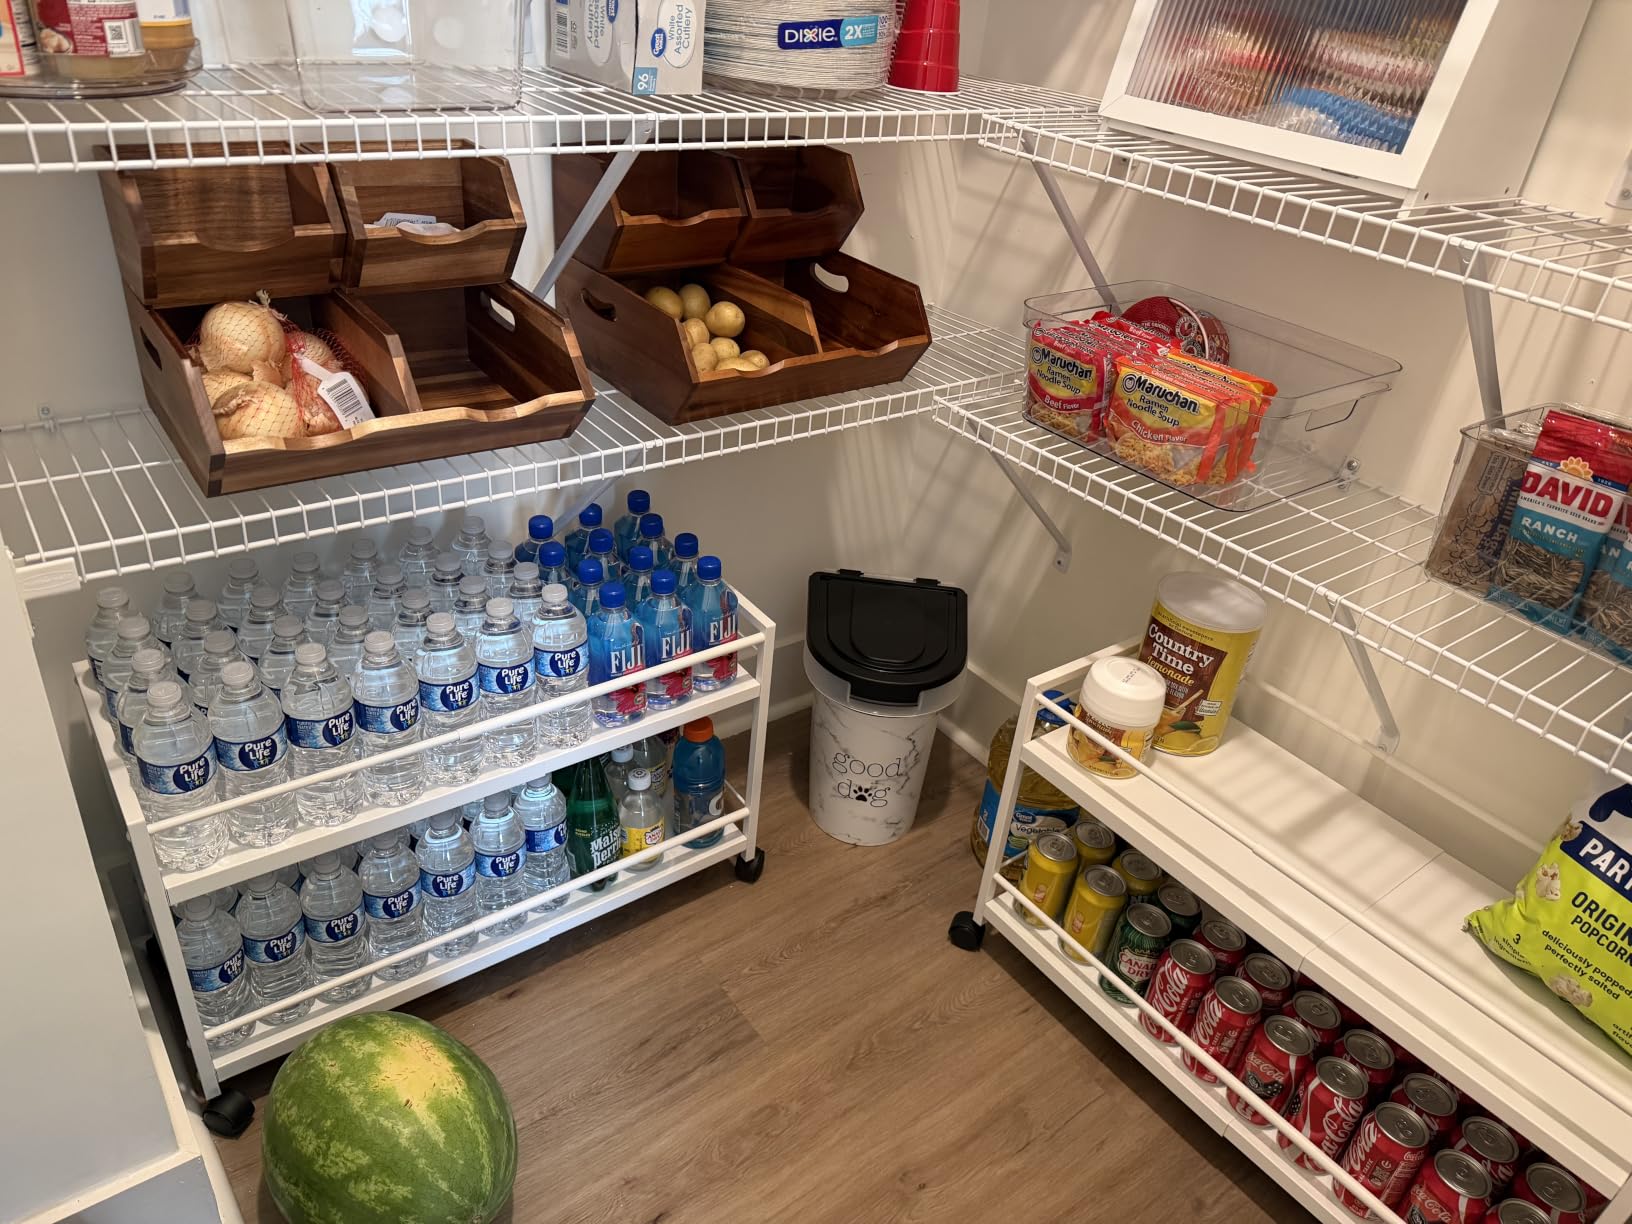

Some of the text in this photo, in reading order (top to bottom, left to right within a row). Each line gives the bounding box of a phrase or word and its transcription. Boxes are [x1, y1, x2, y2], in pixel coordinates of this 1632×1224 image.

[674, 4, 684, 54] Assorted
[682, 8, 693, 49] Cutlery
[844, 24, 864, 40] 2X
[637, 73, 649, 90] 96
[1041, 347, 1093, 380] Maruchan
[1036, 368, 1081, 395] Noodle Soup
[1046, 365, 1071, 382] Ramen
[1044, 394, 1062, 409] Beef
[1135, 375, 1199, 414] Maruchan
[1139, 394, 1169, 413] Ramen
[1126, 398, 1181, 428] Noodle Soup
[1131, 419, 1165, 441] Chicken
[1520, 470, 1614, 518] DAVID
[1520, 516, 1579, 544] RANCH
[708, 614, 736, 643] FIJI
[661, 630, 690, 659] FIJI
[1148, 623, 1215, 668] Country
[555, 650, 577, 661] Pure
[558, 659, 575, 668] Life
[610, 644, 641, 674] FIJI
[1151, 642, 1195, 675] Time
[501, 666, 524, 678] Pure
[504, 675, 523, 685] Life
[446, 682, 470, 695] Pure
[449, 690, 469, 702] Life
[328, 712, 351, 729] Pure
[332, 722, 350, 736] Life
[244, 737, 273, 753] Pure
[248, 747, 272, 761] Life
[180, 757, 206, 775] Pure
[831, 752, 901, 778] good
[184, 768, 205, 782] Life
[496, 853, 517, 865] Pure
[498, 861, 515, 871] Life
[436, 873, 460, 884] Pure
[440, 881, 458, 891] Life
[387, 891, 410, 905] Pure
[330, 914, 354, 929] Pure
[334, 922, 353, 934] Life
[269, 931, 293, 948] Pure
[1512, 933, 1521, 945] 3
[1542, 929, 1593, 969] deliciously
[1544, 943, 1621, 1000] perfectly salted
